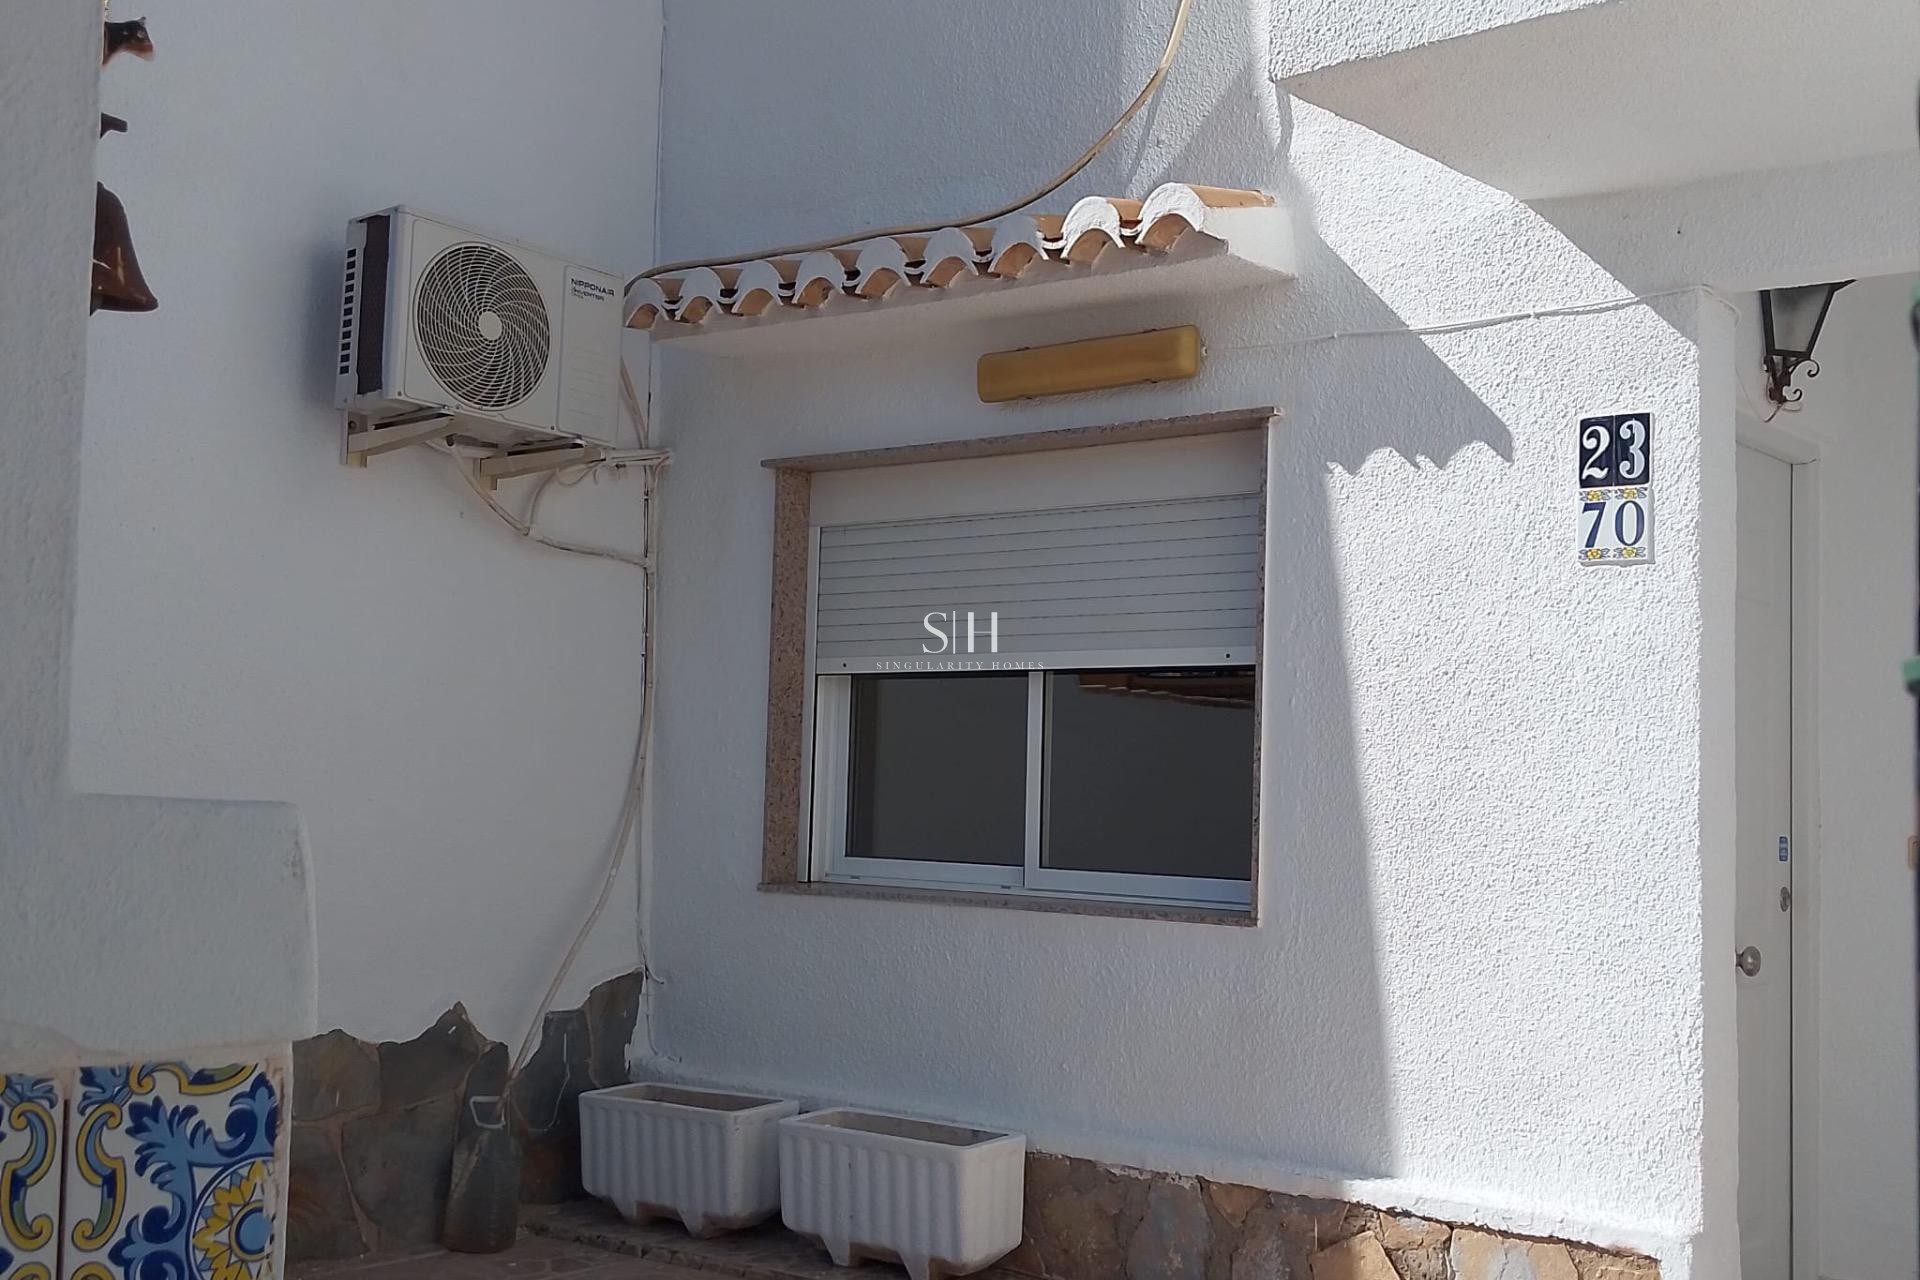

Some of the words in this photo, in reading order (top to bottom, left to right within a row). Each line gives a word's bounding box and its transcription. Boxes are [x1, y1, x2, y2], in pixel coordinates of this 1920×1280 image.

[571, 278, 615, 296] NIPPONAIR
[1581, 419, 1646, 480] 23
[1581, 500, 1645, 548] 70
